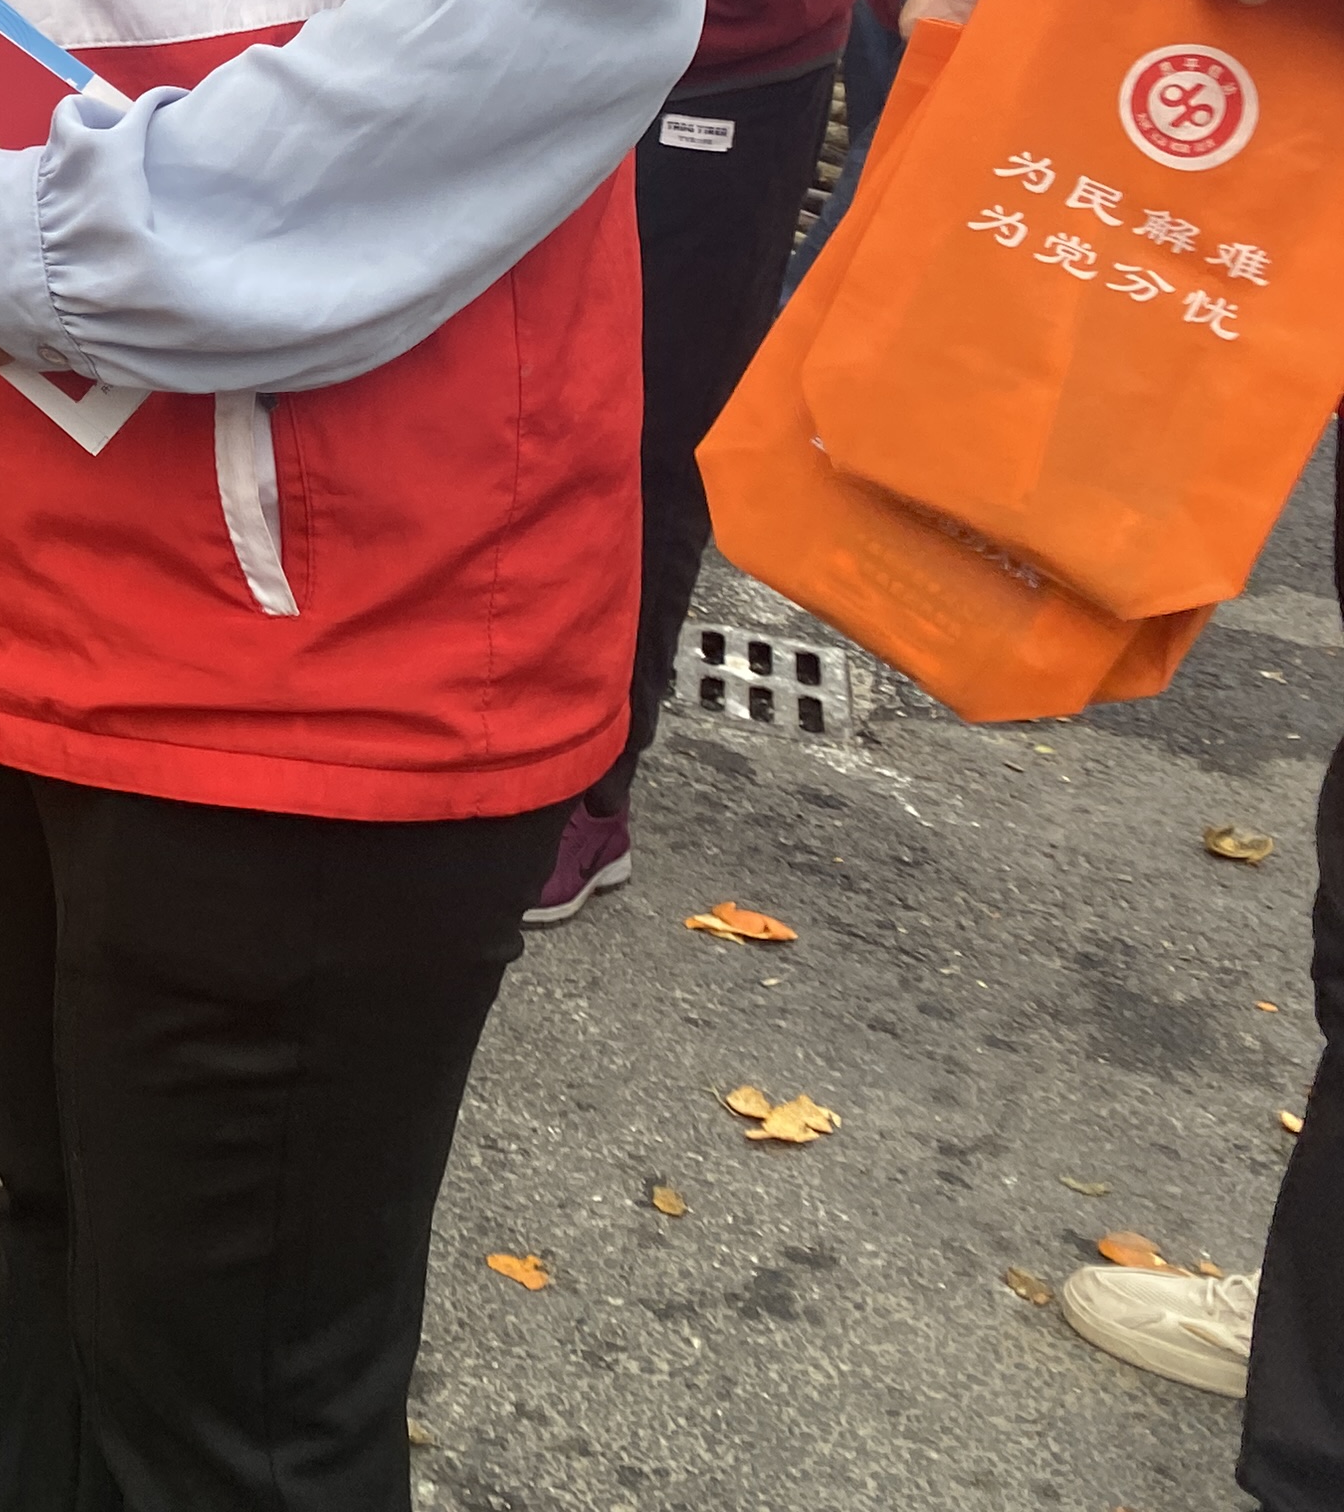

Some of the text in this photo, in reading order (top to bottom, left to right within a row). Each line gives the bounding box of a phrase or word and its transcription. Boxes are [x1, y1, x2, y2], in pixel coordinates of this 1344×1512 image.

[967, 204, 1241, 341] 为党分忧
[993, 151, 1273, 287] 为民解难
